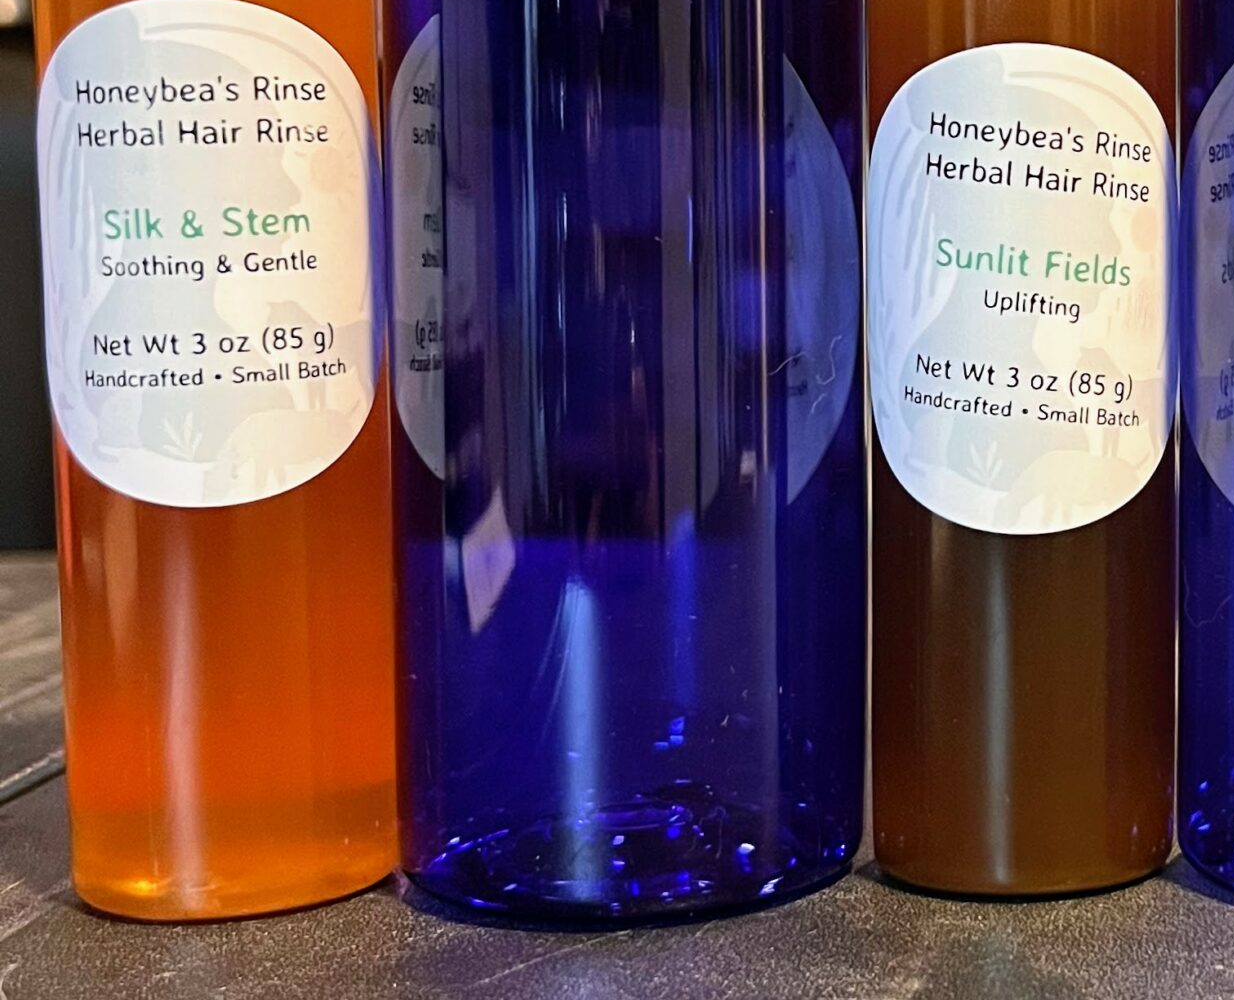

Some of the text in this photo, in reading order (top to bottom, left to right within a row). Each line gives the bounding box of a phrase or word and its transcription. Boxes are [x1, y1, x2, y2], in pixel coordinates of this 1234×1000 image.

[75, 76, 326, 109] Honeybea's Rinse
[77, 119, 328, 147] Herbal Hair Rinse
[930, 112, 1152, 163] Honeybea's Rinse
[926, 153, 1150, 202] Herbal Hair Rinse
[103, 207, 310, 239] Silk & Stem
[101, 250, 318, 281] Soothing & Gentle
[936, 238, 1131, 286] Sunlit Fields
[984, 290, 1081, 323] Uplifting
[93, 323, 334, 357] Net Wt 3 oz (85 g)
[85, 368, 204, 387] Handcrafted
[232, 363, 289, 383] Small
[299, 359, 346, 379] Batch
[916, 354, 1133, 404] Net Wt 3 oz (85 g)
[904, 386, 1012, 417] Handcrafted
[1038, 404, 1089, 425] Small
[1097, 408, 1140, 427] Batch
